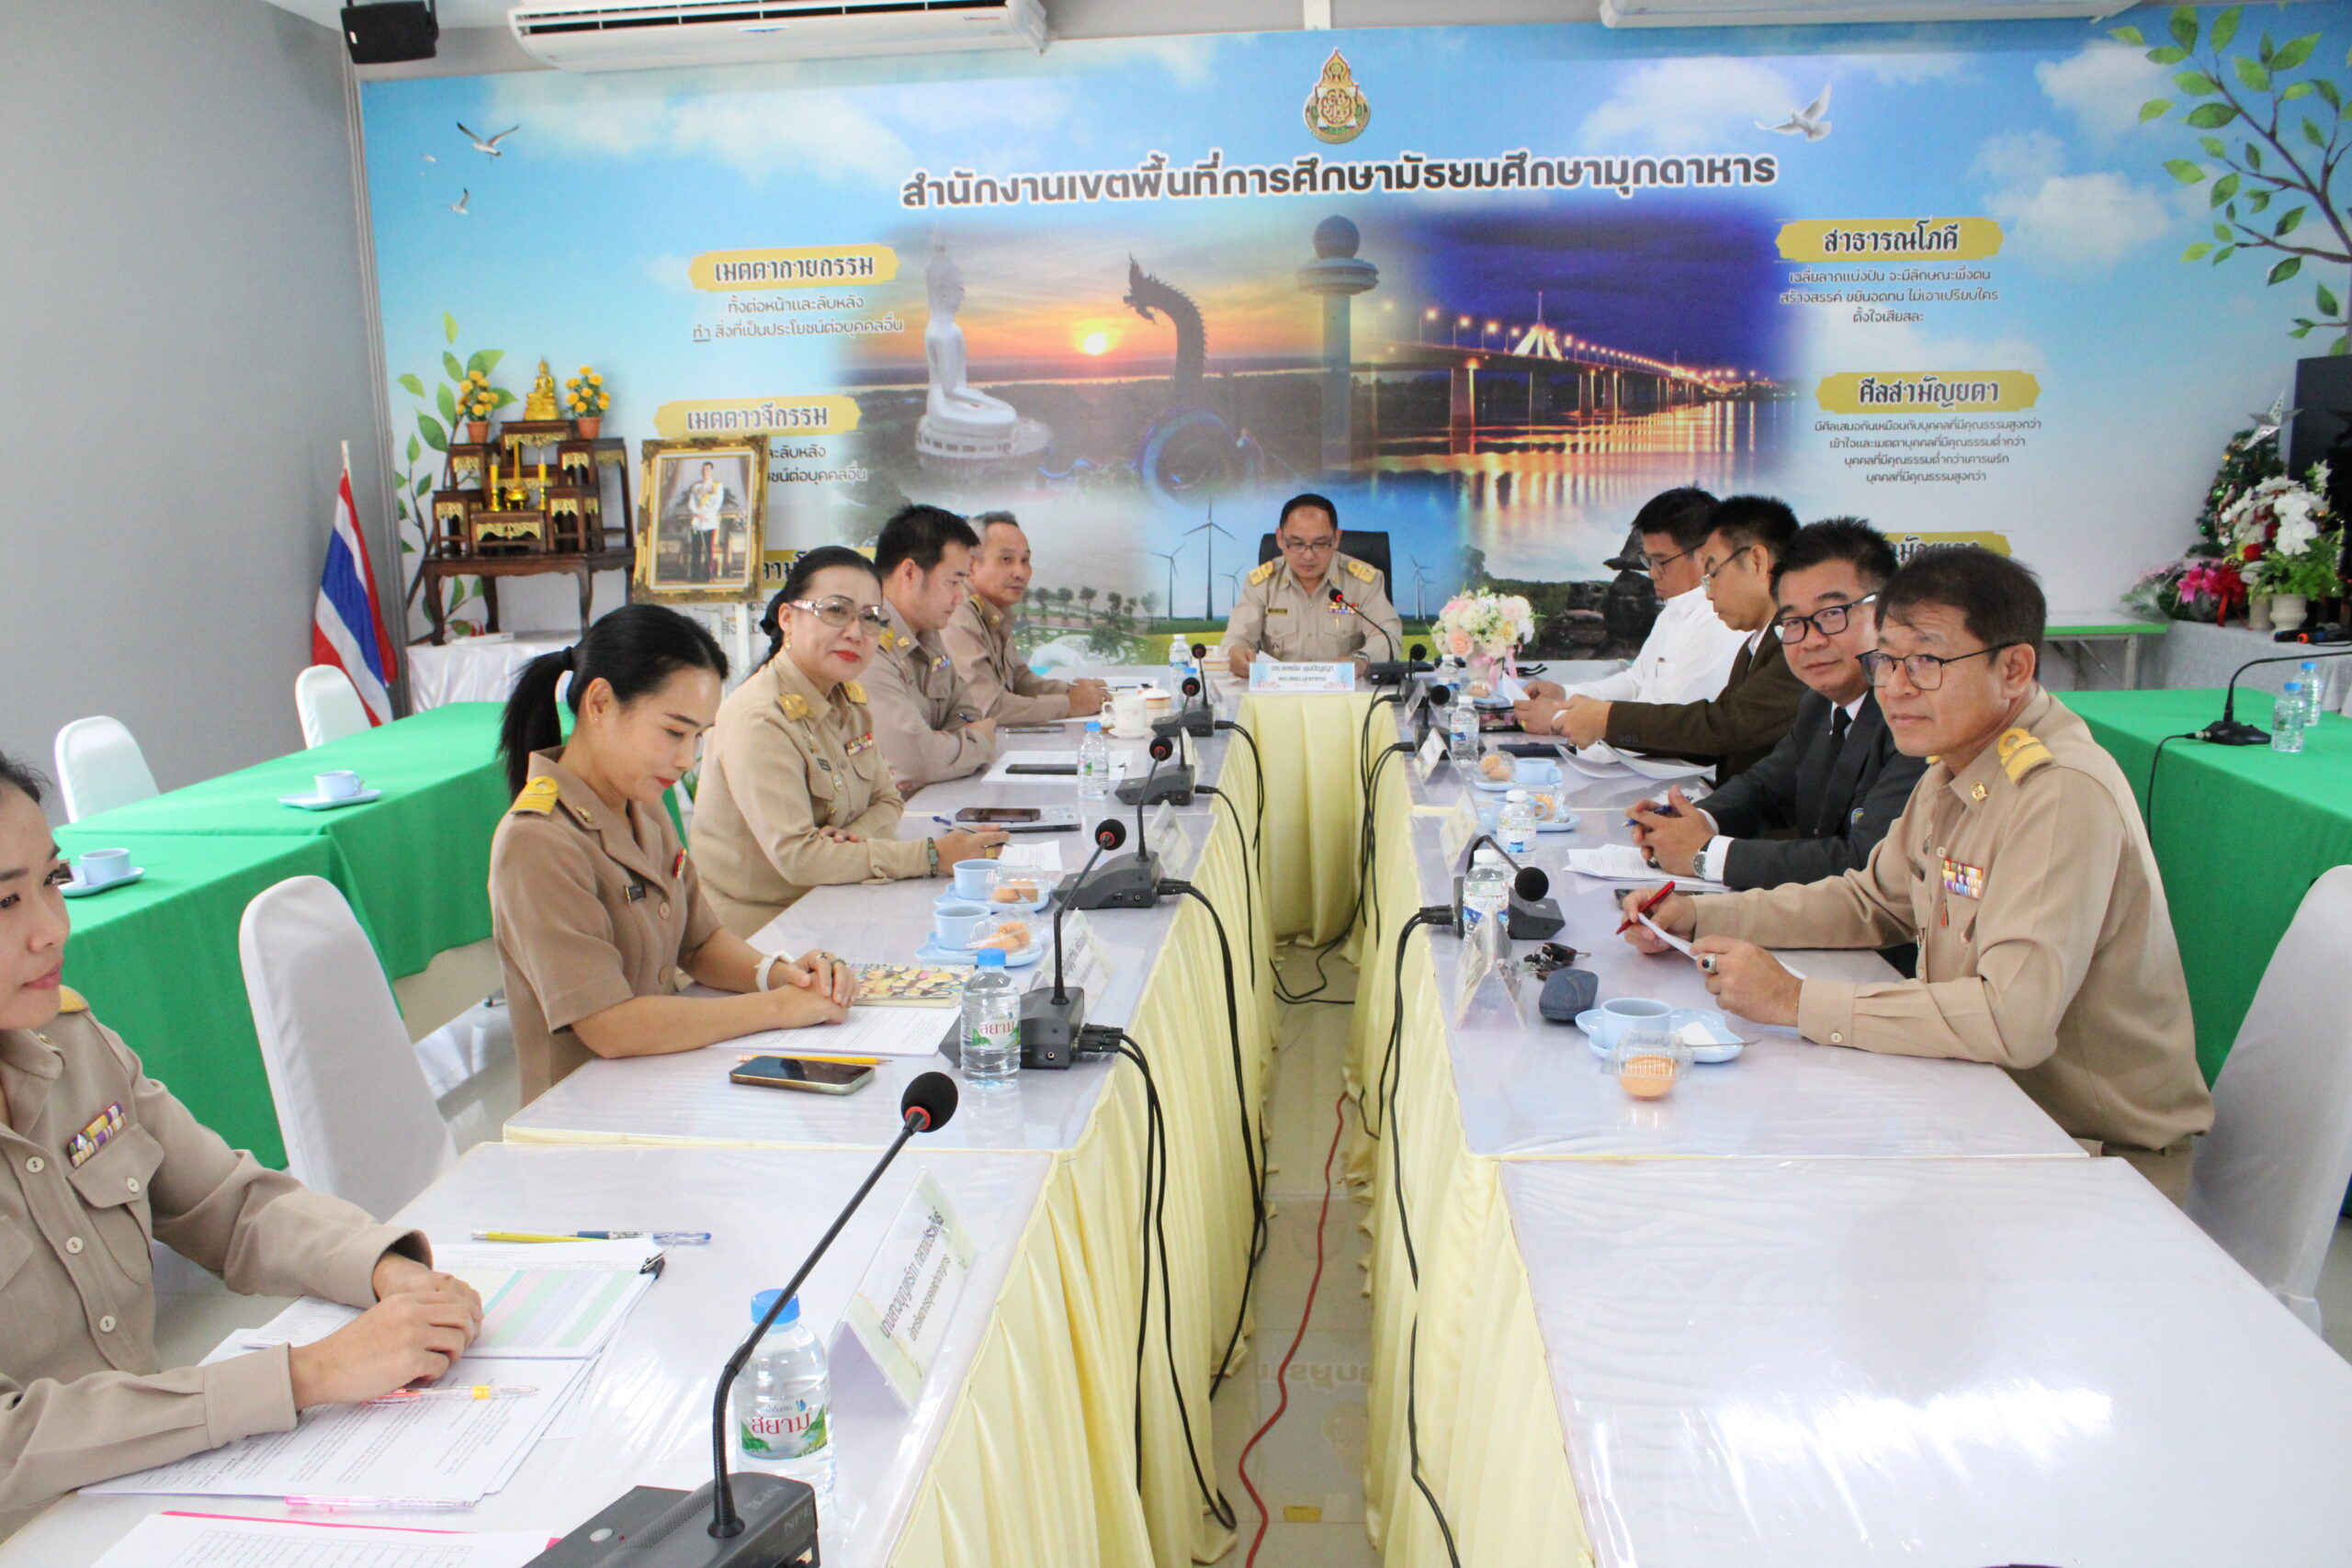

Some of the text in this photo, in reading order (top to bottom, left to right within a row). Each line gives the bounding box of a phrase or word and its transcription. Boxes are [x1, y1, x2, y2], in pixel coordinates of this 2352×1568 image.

[902, 152, 1778, 207] สำนักงานเขตพื้นที่การศึกษามัธยมศึกษามุกดาหาร
[1824, 220, 1960, 253] สาธารณโภคี
[728, 294, 865, 314] ทั้งต่อหน้าและลับหลัง
[1846, 288, 1905, 303] ขยันอดทน
[1908, 287, 1998, 302] ไม่เอาเปรียบใคร
[1852, 307, 1924, 323] ตั้งใจเสียสละ
[693, 312, 904, 340] ทำ สิ่งที่เป็นประโยชน์ต่อบุคคลอื่น
[979, 1021, 1015, 1035] สยาม
[751, 1413, 810, 1435] สยาม
